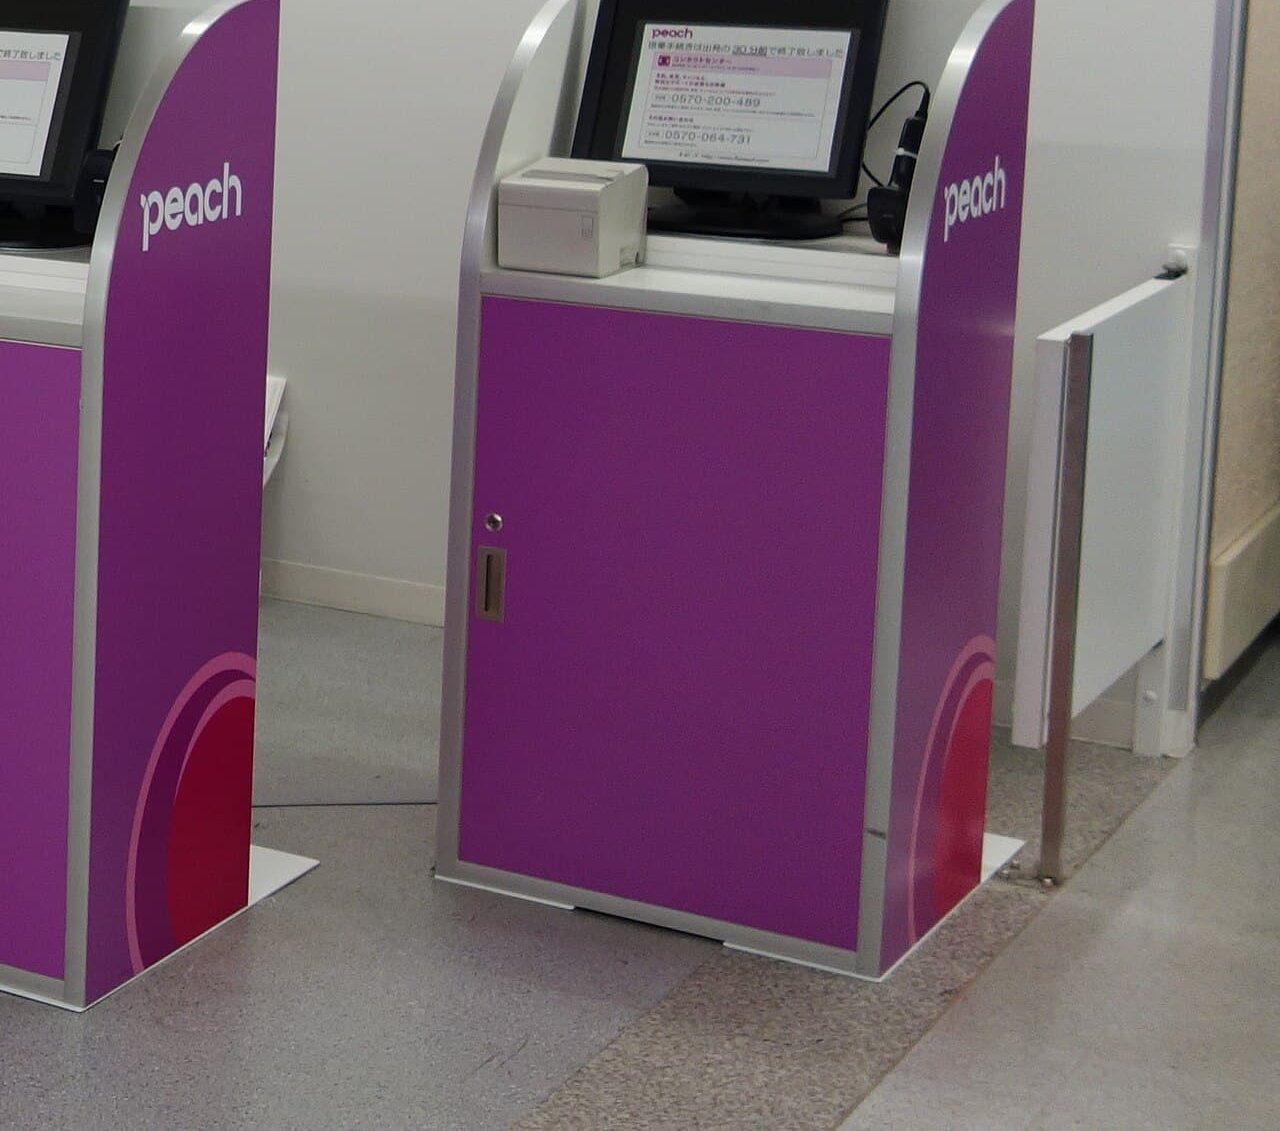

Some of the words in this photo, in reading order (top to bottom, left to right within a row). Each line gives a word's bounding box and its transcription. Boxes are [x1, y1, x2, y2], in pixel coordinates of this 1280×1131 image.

[652, 28, 693, 39] peach
[671, 93, 760, 108] 0570-200-489
[141, 163, 242, 251] peach
[943, 156, 1006, 242] peach
